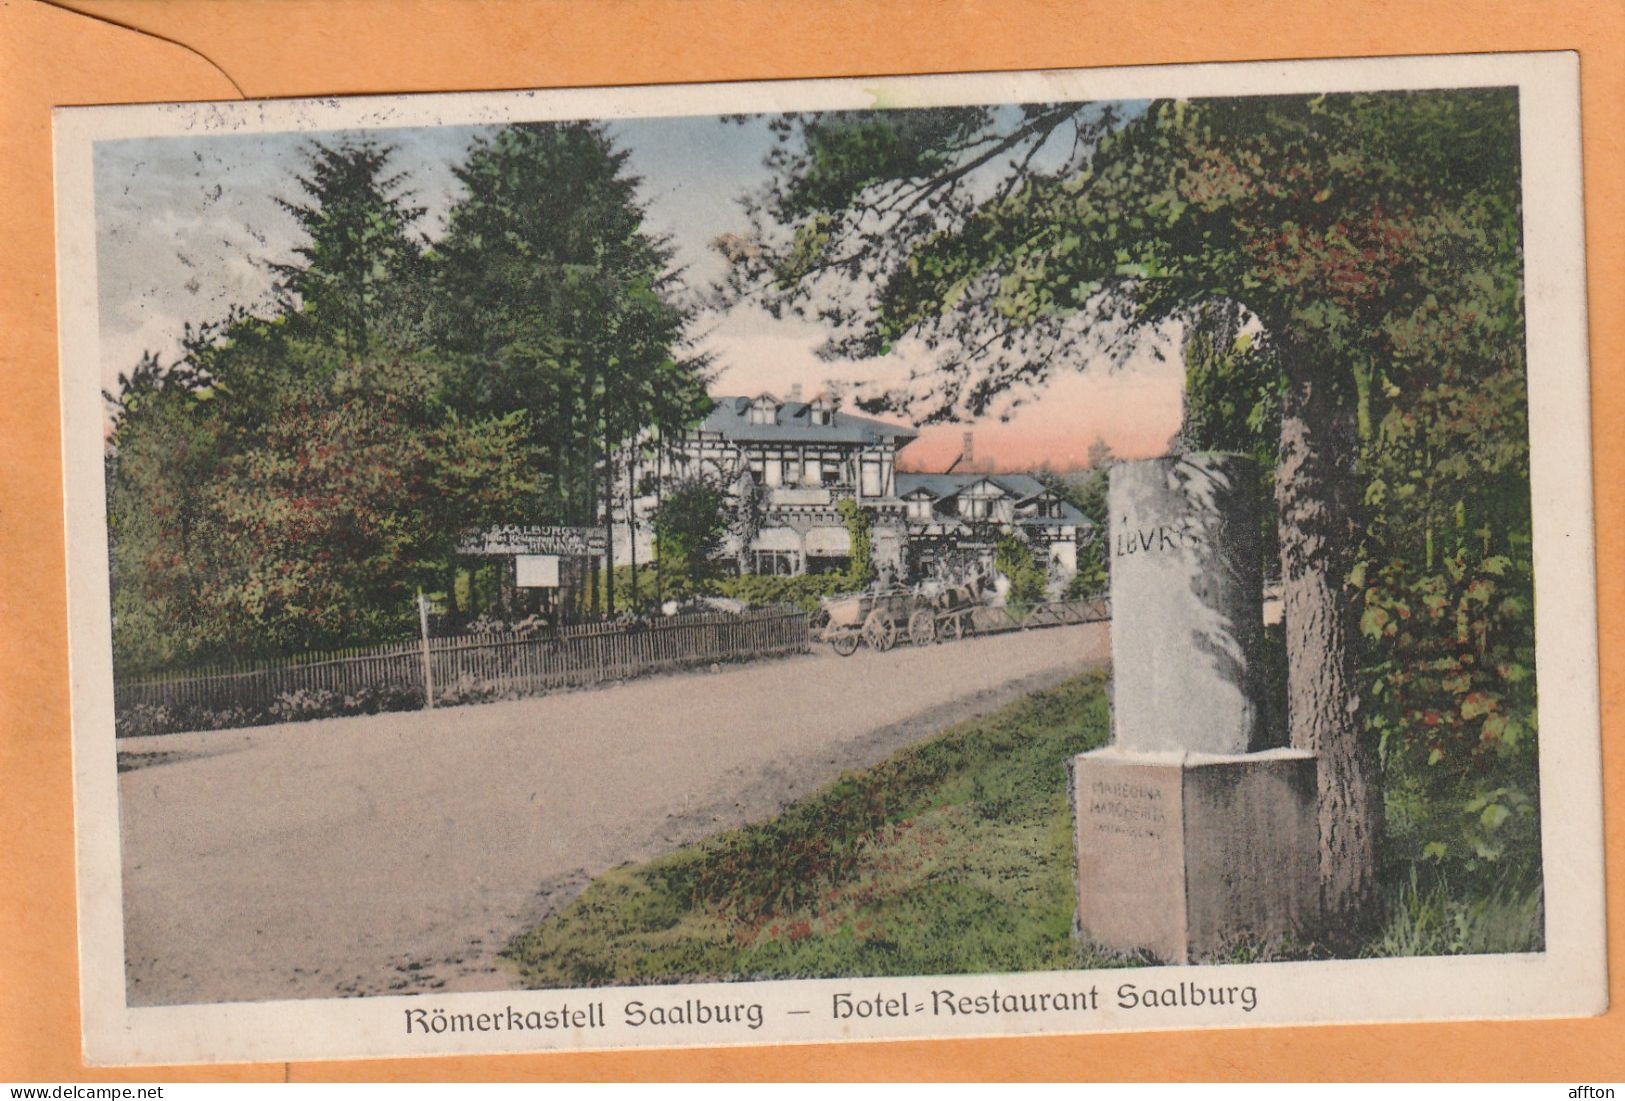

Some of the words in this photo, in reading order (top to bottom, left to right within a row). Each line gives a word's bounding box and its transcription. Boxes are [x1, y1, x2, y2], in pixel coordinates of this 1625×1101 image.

[403, 1003, 605, 1034] Römerkastell
[624, 999, 764, 1030] Saalburg
[1117, 982, 1258, 1012] Saalburg
